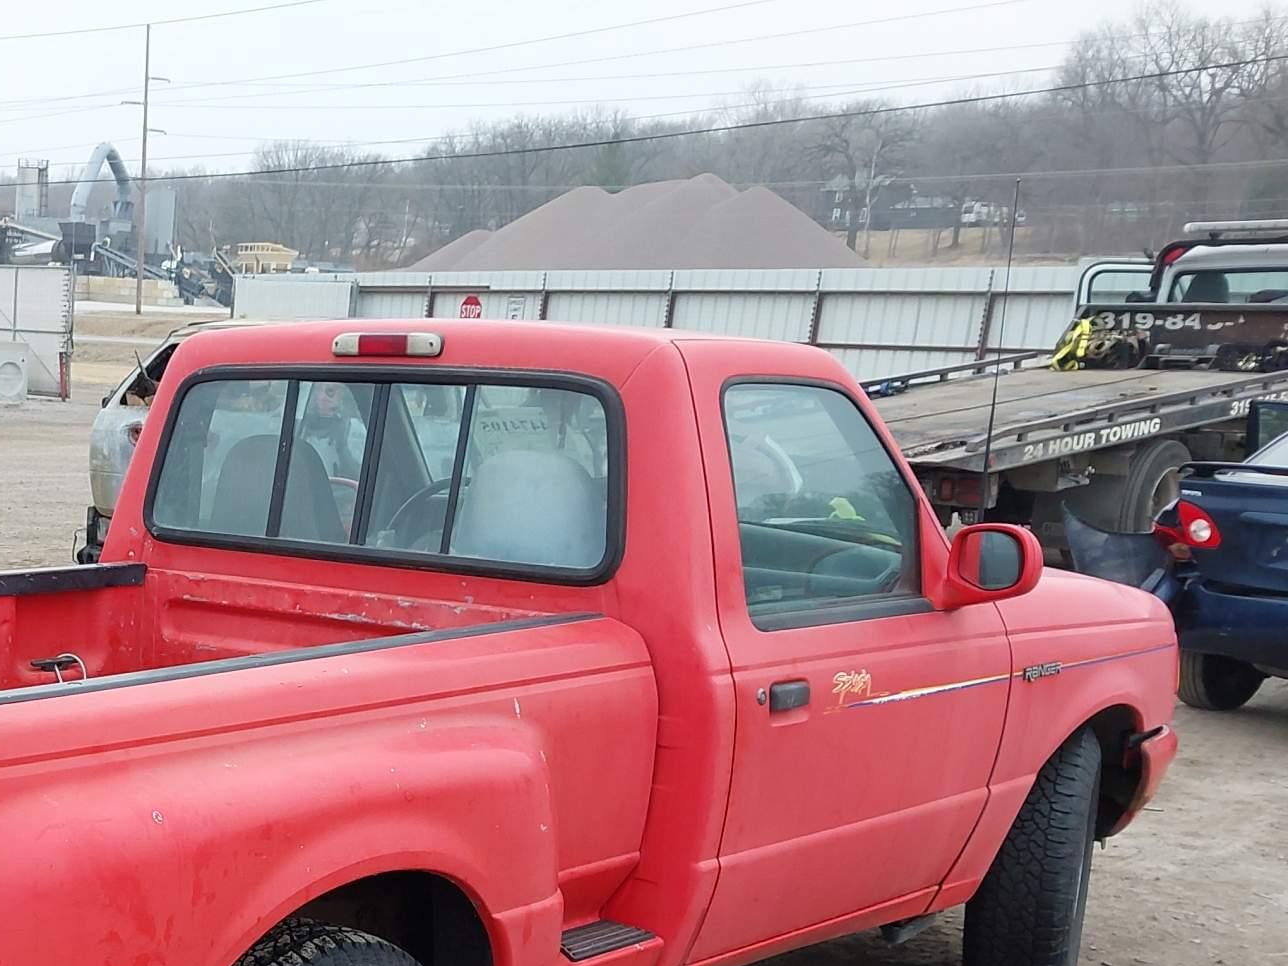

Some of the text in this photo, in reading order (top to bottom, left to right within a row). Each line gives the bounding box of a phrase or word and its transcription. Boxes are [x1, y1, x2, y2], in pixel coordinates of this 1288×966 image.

[461, 305, 481, 318] STOP
[1023, 417, 1161, 460] 24 HOUR TOWING
[1023, 662, 1062, 682] RANGER
